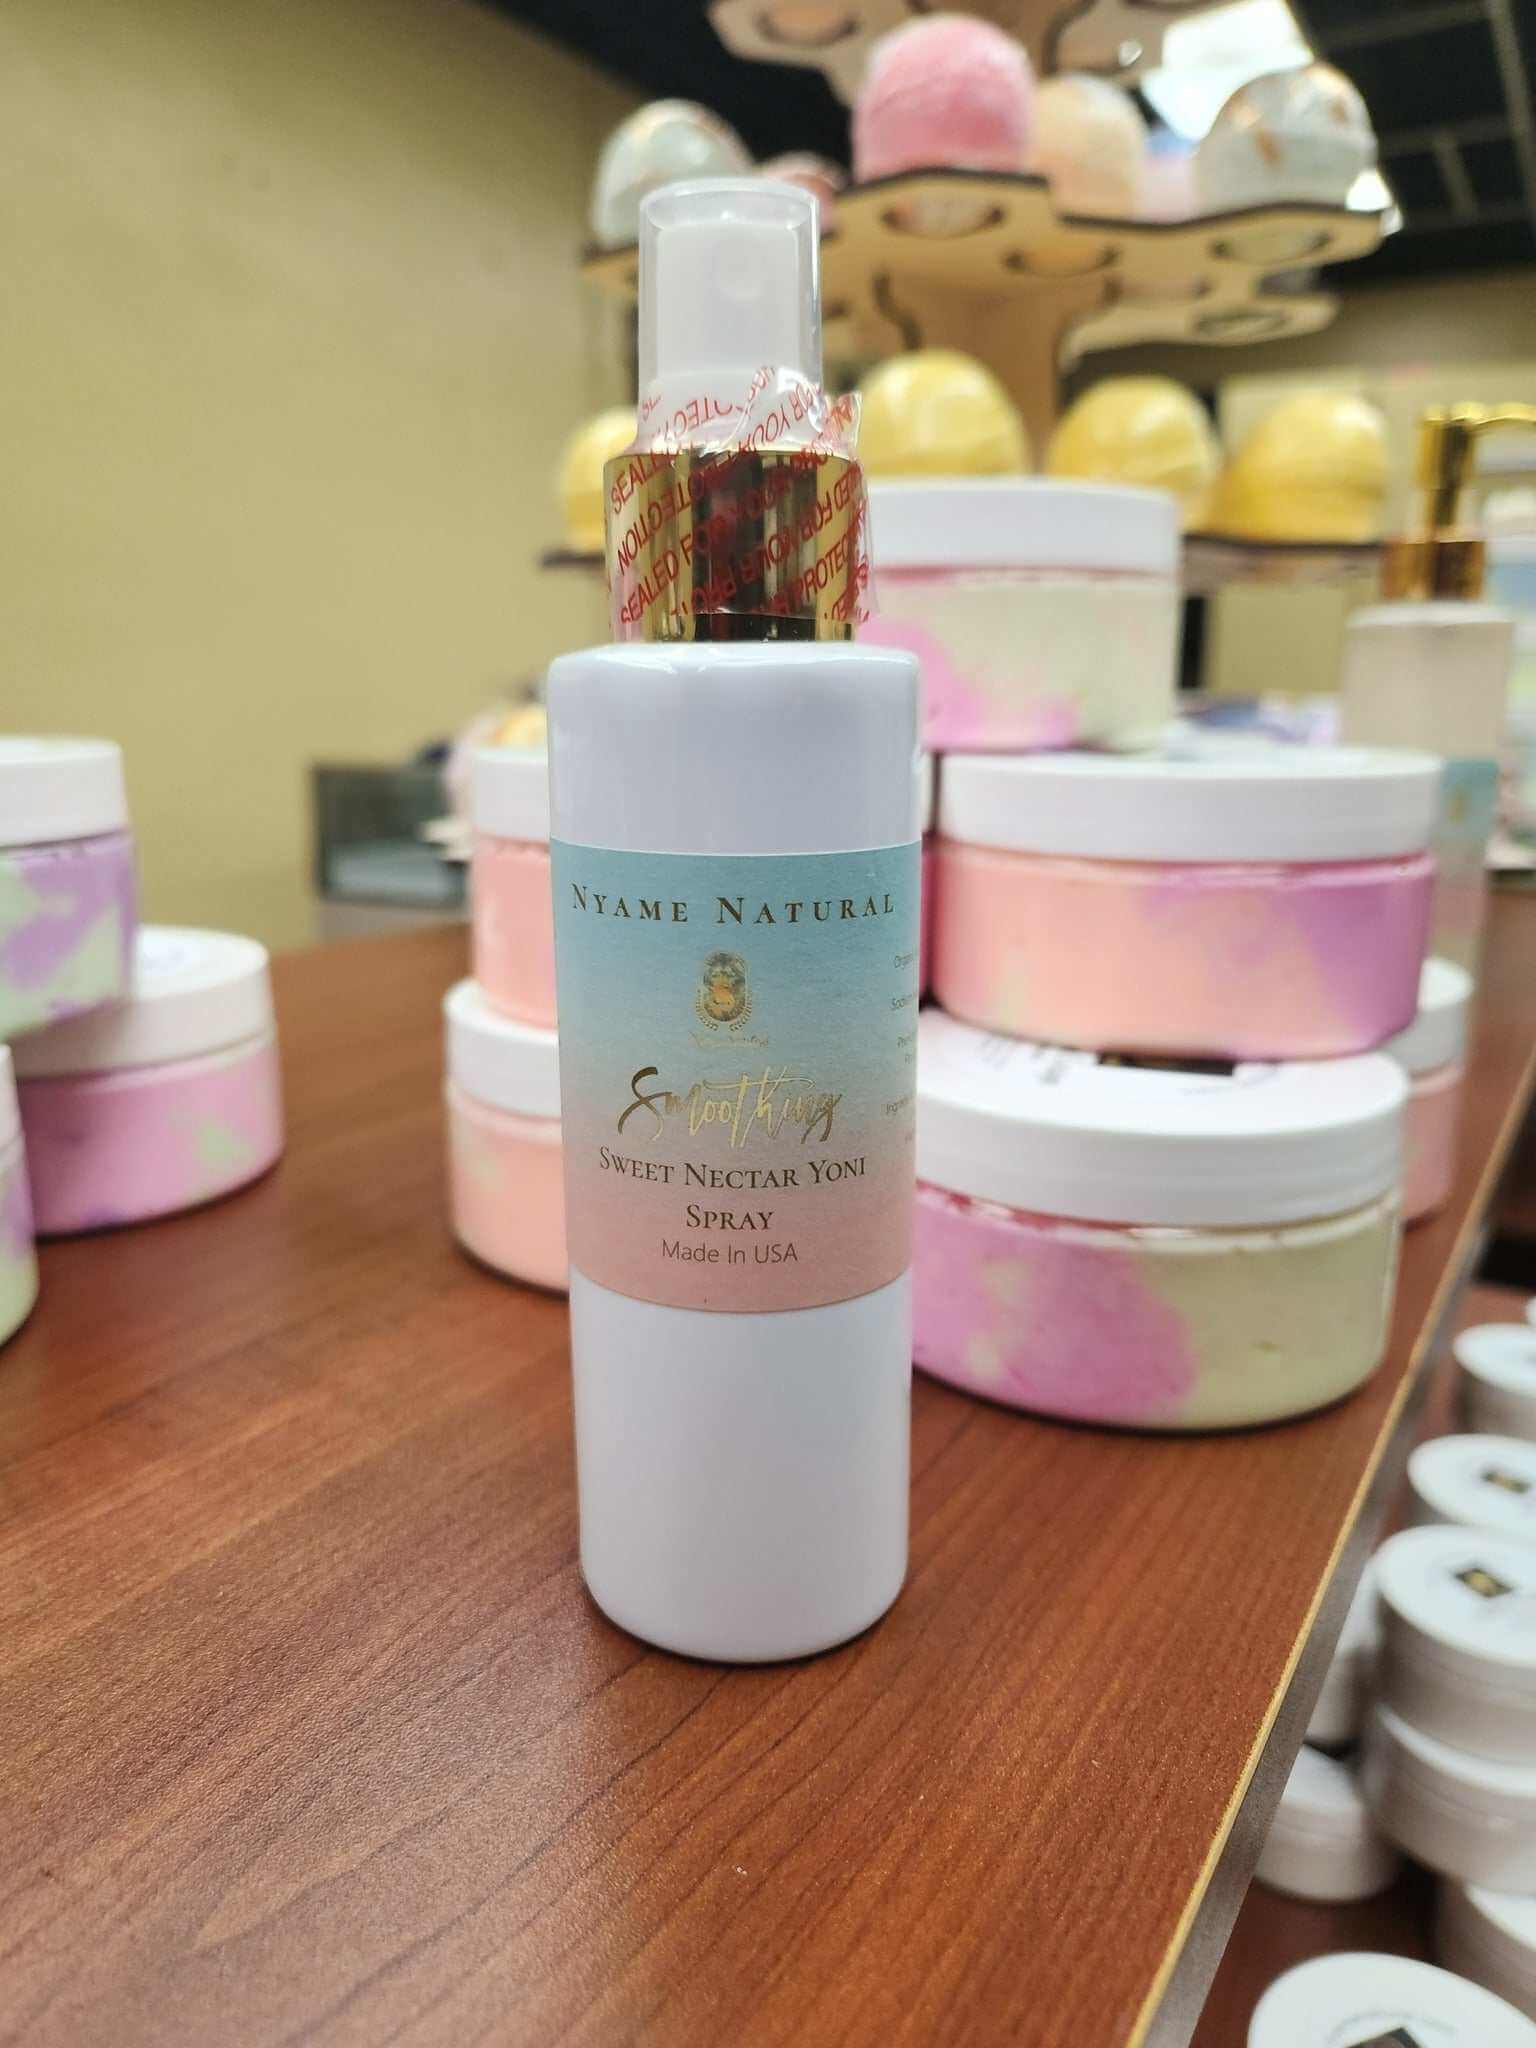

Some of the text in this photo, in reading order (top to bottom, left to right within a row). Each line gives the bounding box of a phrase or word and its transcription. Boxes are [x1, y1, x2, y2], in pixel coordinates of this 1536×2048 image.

[620, 550, 680, 624] SEALED
[571, 882, 895, 925] NYAME NATURAL
[599, 1145, 866, 1189] SWEET NECTAR YONI
[685, 1203, 775, 1231] SPRAY
[661, 1239, 799, 1266] Made In USA
